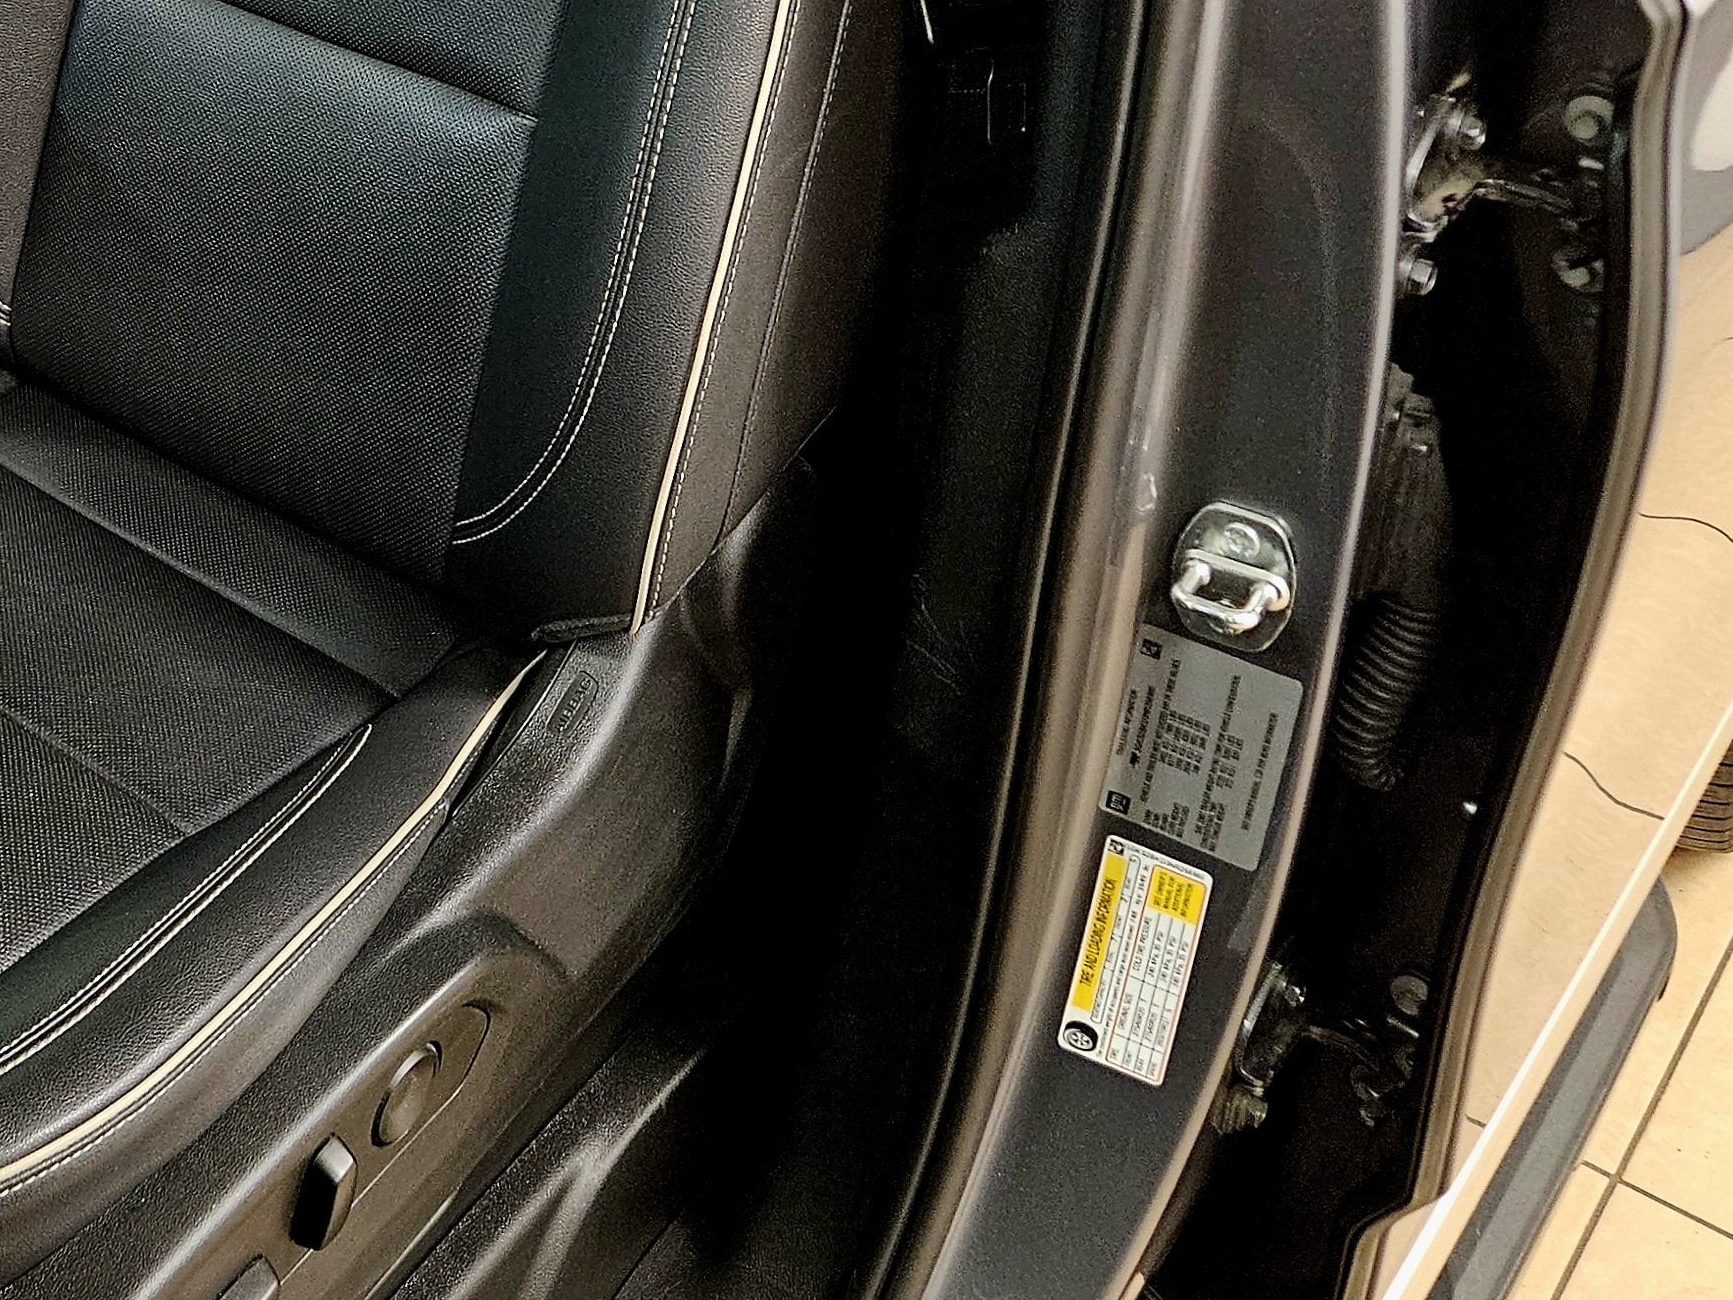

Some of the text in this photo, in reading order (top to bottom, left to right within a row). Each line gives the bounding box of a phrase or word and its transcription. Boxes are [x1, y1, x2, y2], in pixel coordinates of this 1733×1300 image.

[1086, 922, 1106, 957] LOADING
[1082, 952, 1098, 971] AND
[1078, 968, 1094, 988] TIRE
